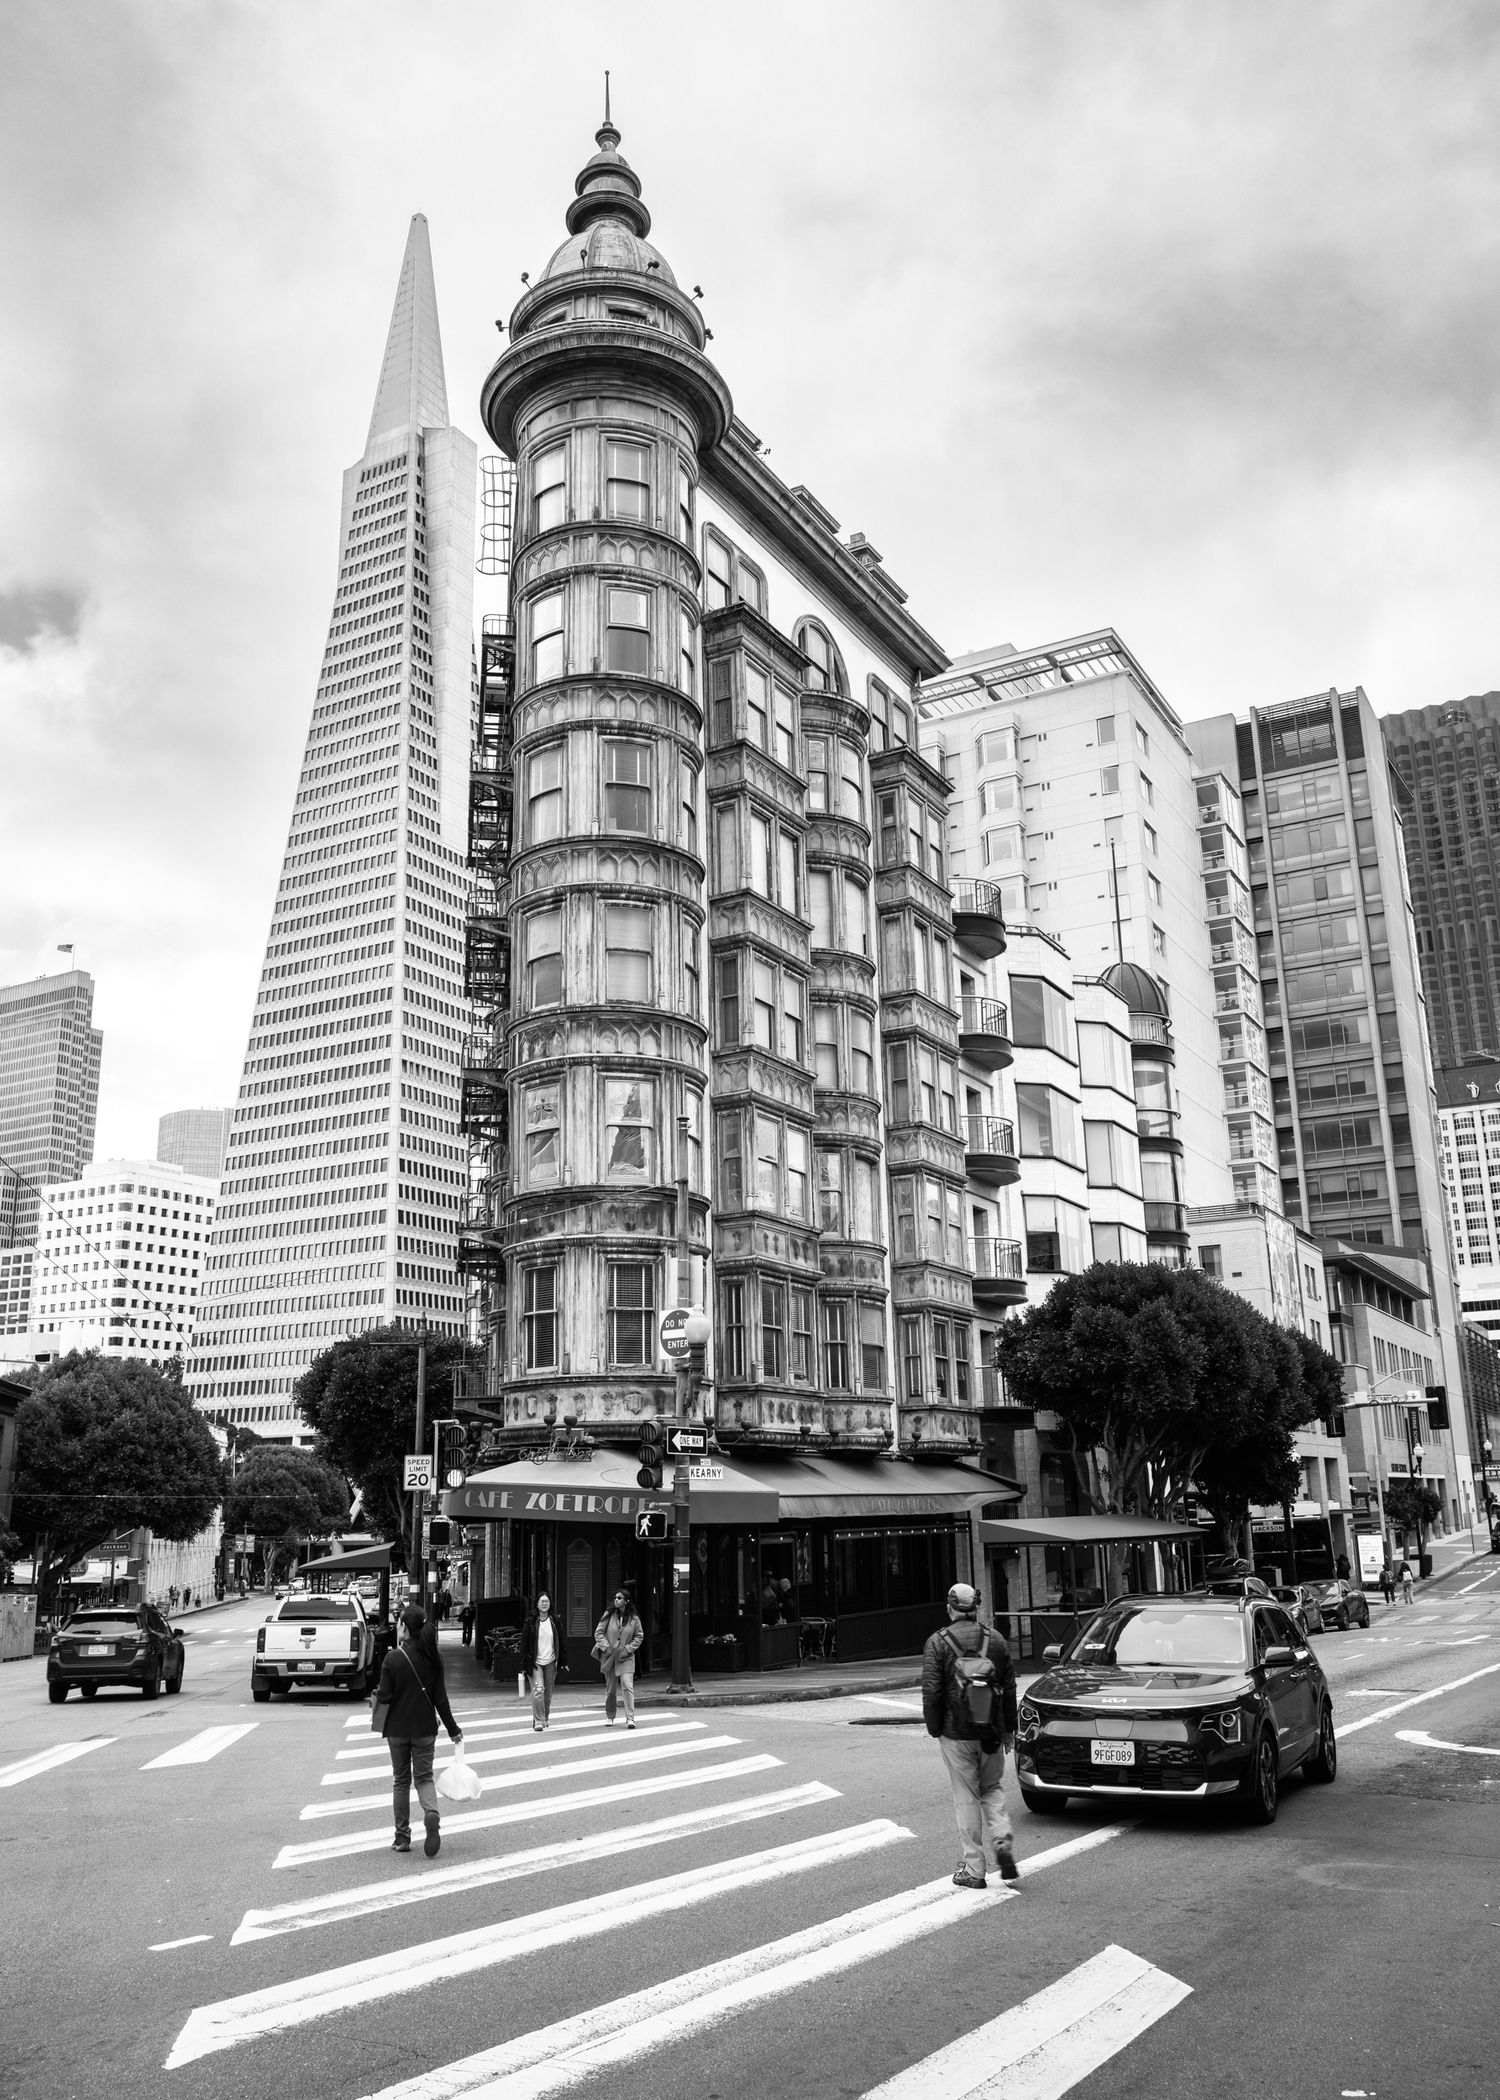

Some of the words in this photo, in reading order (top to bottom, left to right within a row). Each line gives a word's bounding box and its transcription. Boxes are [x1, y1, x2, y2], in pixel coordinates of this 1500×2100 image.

[665, 1320, 675, 1328] DO
[678, 1318, 688, 1327] NO
[667, 1340, 689, 1349] ENTER
[680, 1436, 690, 1445] ONE
[692, 1436, 703, 1445] WAY
[690, 1468, 722, 1478] KEARNY
[407, 1473, 429, 1487] 20
[464, 1490, 513, 1509] CAFE
[1094, 1749, 1132, 1761] 9FGF089
